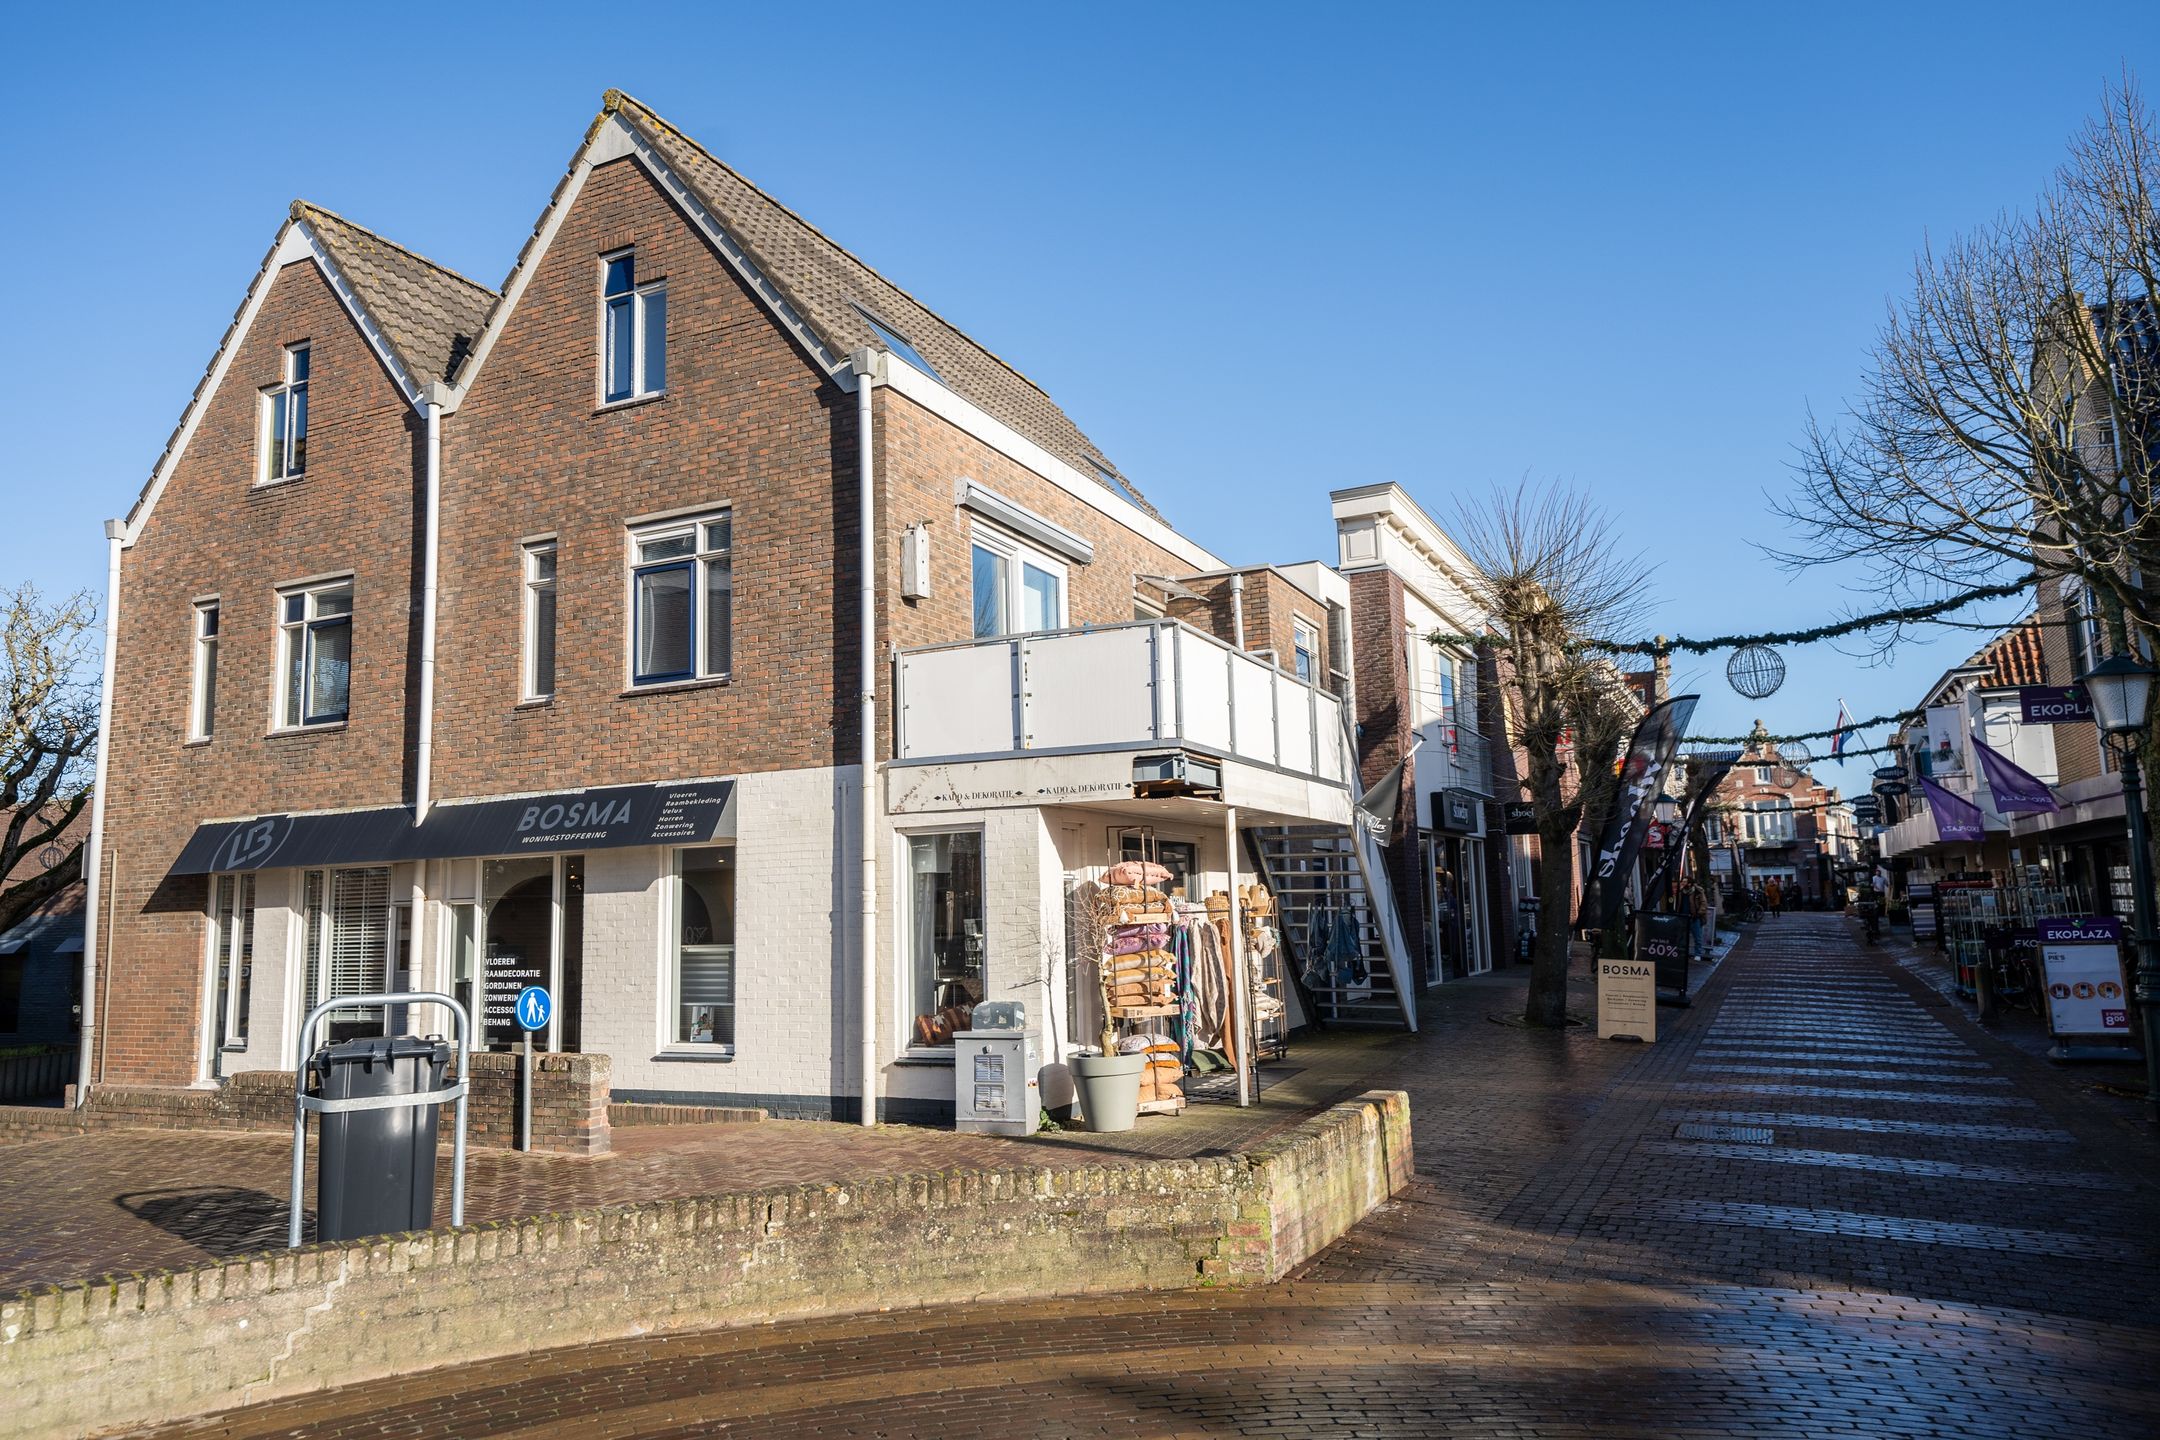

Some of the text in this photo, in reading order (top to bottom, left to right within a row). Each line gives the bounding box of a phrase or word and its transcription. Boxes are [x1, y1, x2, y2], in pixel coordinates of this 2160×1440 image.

[2030, 703, 2094, 716] EKOPLA
[1046, 782, 1124, 795] KADO & DEKORATIE
[942, 792, 963, 801] KADO
[971, 789, 1014, 800] DEKORATIE
[665, 797, 721, 807] Raambekleding
[516, 798, 631, 832] BOSMA
[655, 822, 694, 830] Zonwering
[521, 831, 607, 844] WONINGSTOFFERING
[651, 830, 695, 838] Accessoires
[2047, 929, 2112, 940] EKOPLAZA
[2014, 939, 2038, 948] EKO
[1640, 943, 1678, 957] -60%
[485, 957, 516, 966] VLOEREN
[484, 969, 541, 978] RAAMDECORATIE
[1602, 964, 1651, 977] BOSMA
[484, 982, 522, 990] GORDIJNEN
[483, 994, 519, 1002] ZONWERIN
[483, 1006, 516, 1014] ACCESSOI
[483, 1018, 511, 1026] BEHANG
